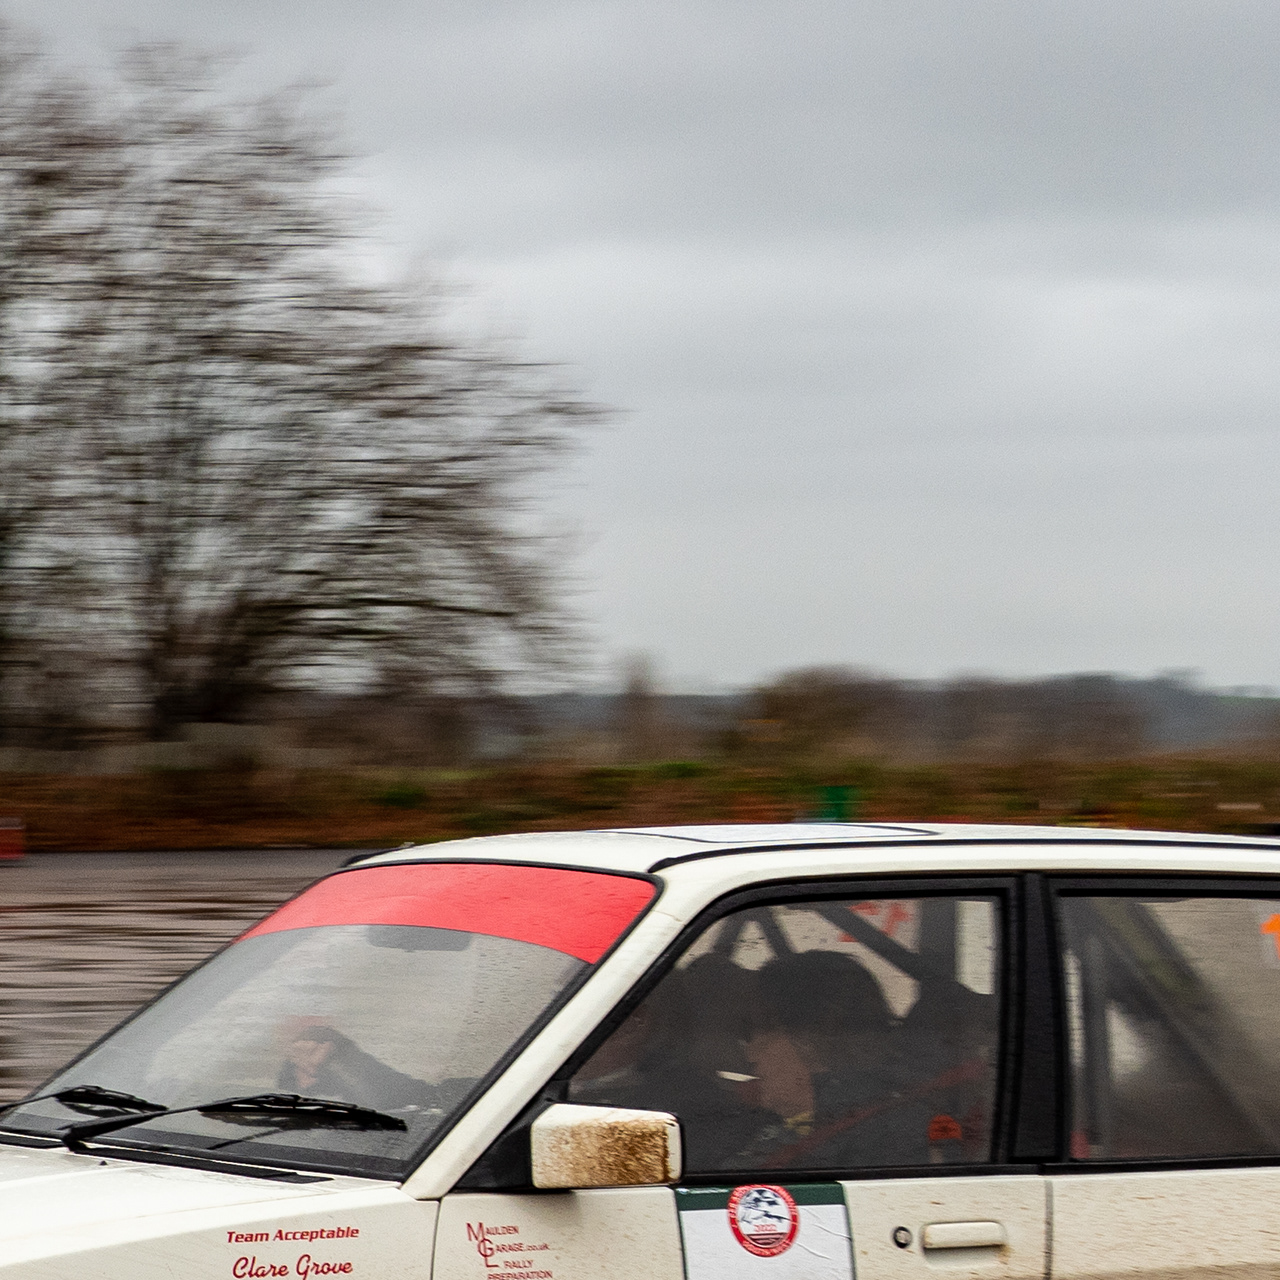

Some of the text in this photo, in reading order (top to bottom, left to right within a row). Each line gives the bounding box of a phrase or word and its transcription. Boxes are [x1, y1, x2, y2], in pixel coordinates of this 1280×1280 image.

[227, 1226, 360, 1243] Team Acceptable
[232, 1256, 289, 1279] Clare
